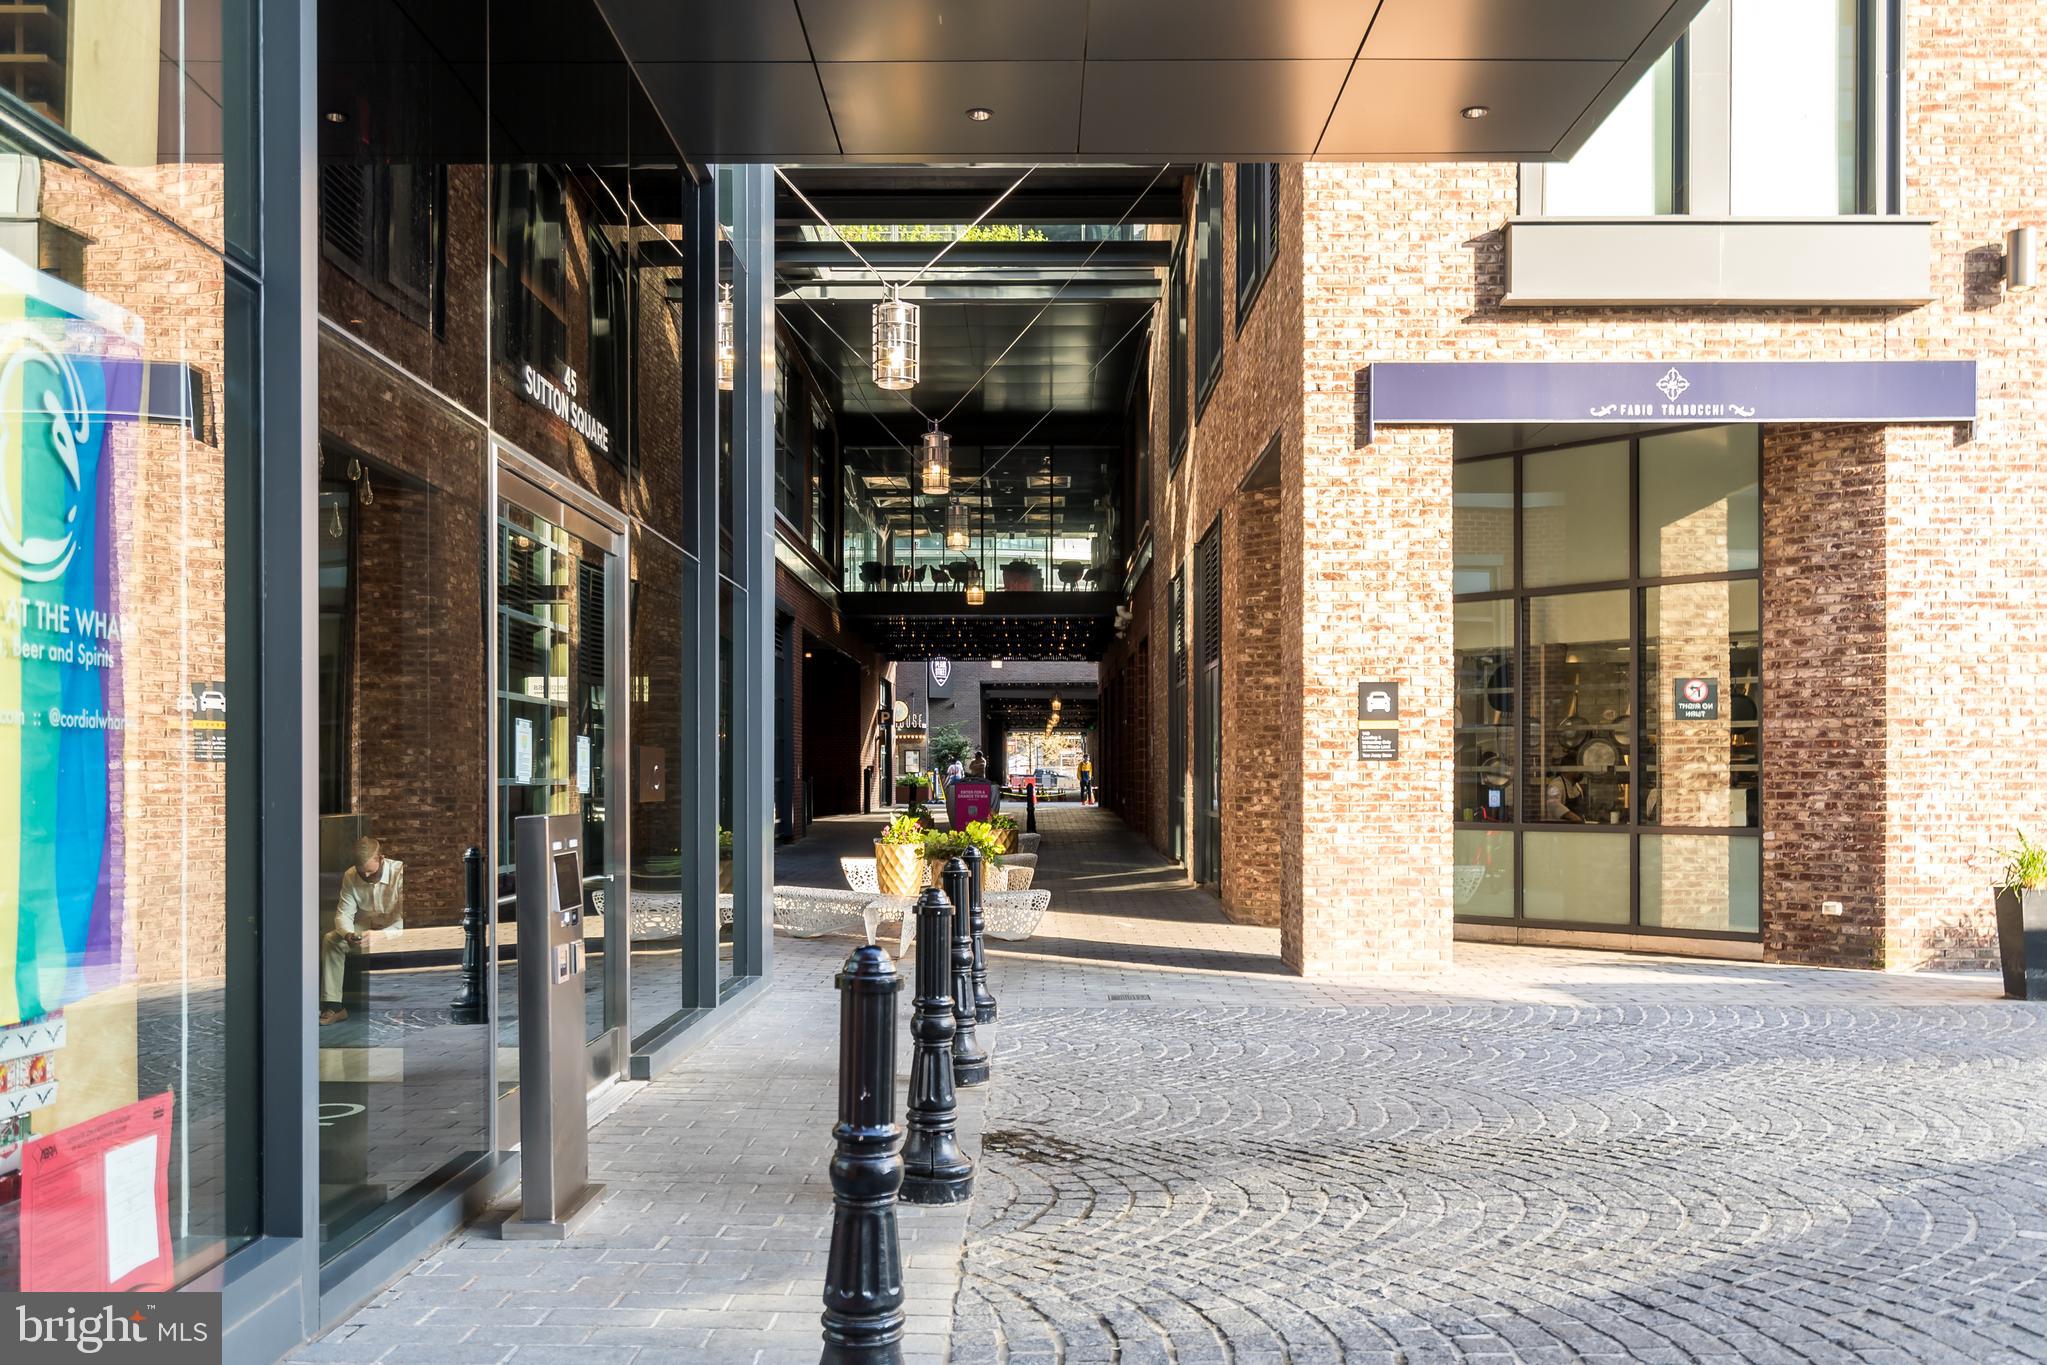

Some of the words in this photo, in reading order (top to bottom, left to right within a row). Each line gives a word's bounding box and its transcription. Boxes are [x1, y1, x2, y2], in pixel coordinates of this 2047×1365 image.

[563, 365, 577, 397] 45
[524, 364, 569, 422] SUTTON
[570, 401, 609, 453] SQUARE
[1620, 404, 1653, 416] FABIO
[1661, 404, 1724, 416] TRABOCCHI
[4, 598, 30, 628] AT
[35, 600, 70, 633] THE
[75, 607, 128, 641] WHA
[48, 640, 73, 663] and
[78, 643, 115, 671] Spirits
[49, 706, 128, 731] @cordialwhar
[881, 711, 890, 723] P
